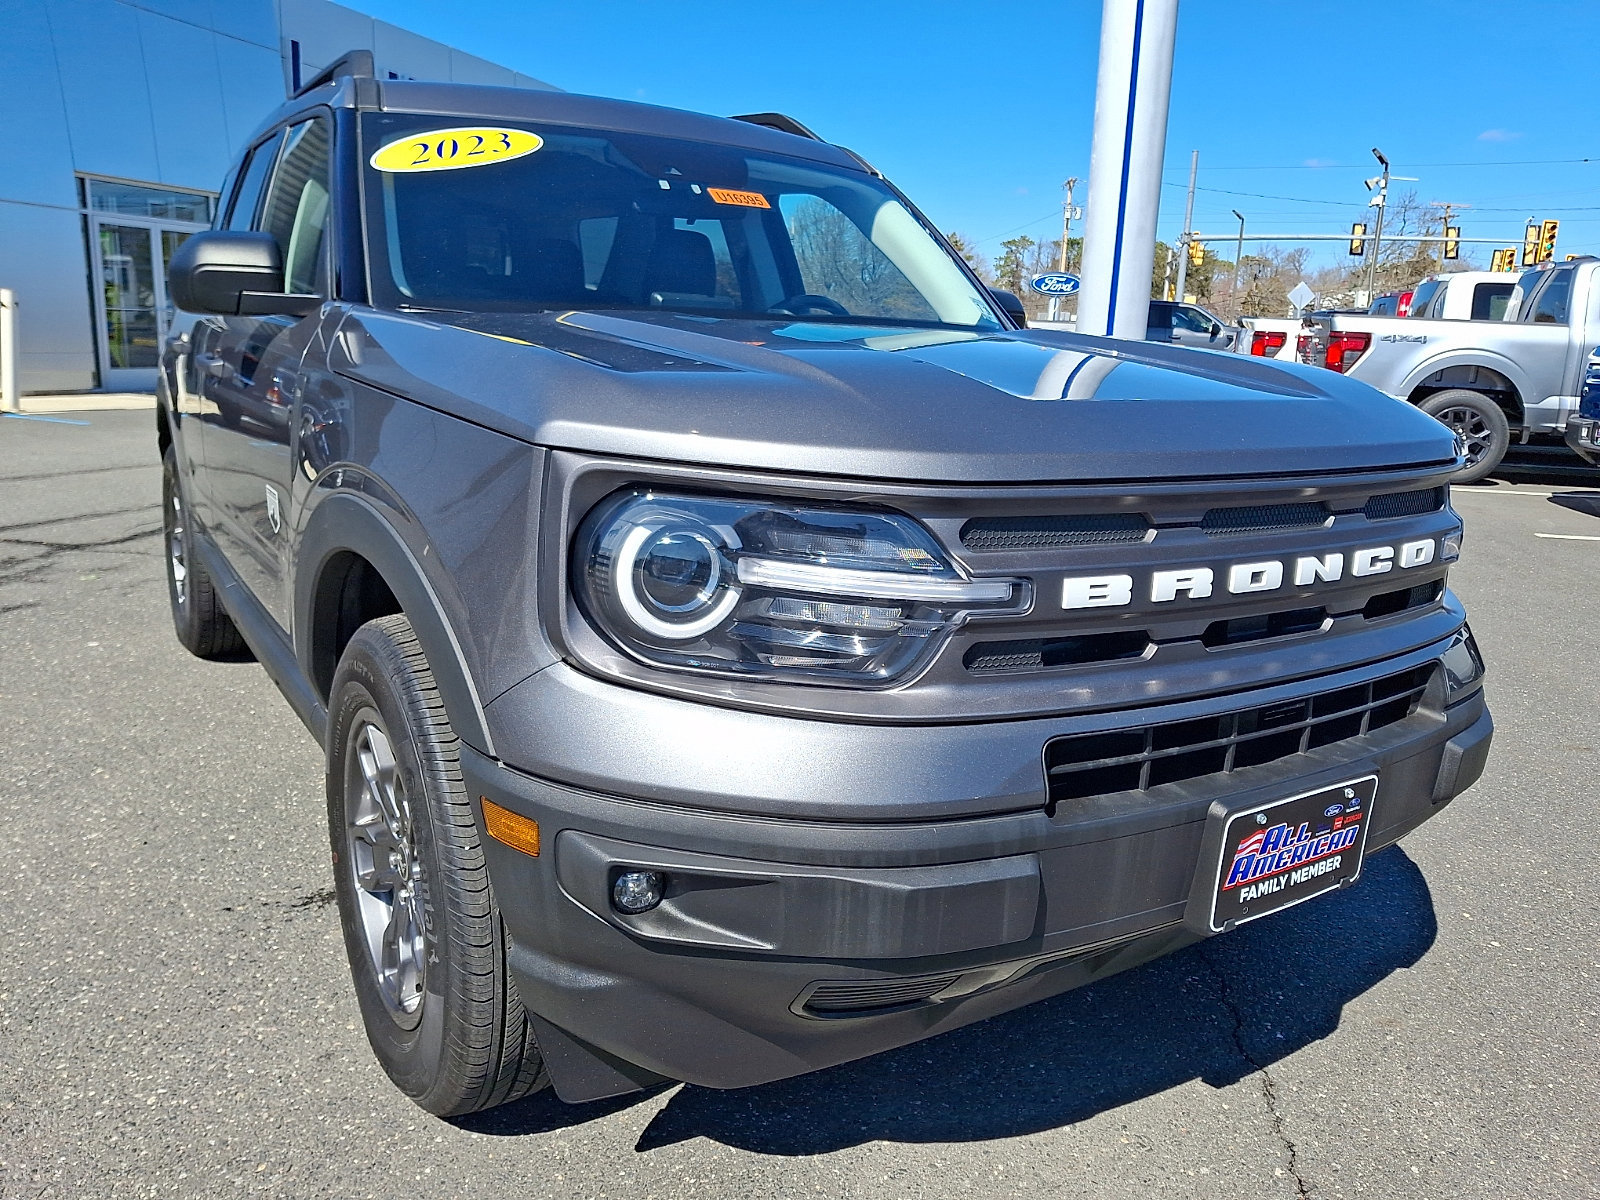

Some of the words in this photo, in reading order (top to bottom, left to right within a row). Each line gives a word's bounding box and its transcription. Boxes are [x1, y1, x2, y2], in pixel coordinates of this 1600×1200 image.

[409, 133, 511, 165] 2023
[715, 191, 764, 206] U16395
[1041, 276, 1075, 292] Ford
[1062, 538, 1435, 610] BRONCO
[1225, 825, 1360, 888] AMERICAN
[1239, 874, 1291, 903] FAMILY
[1290, 856, 1342, 886] MEMBER
